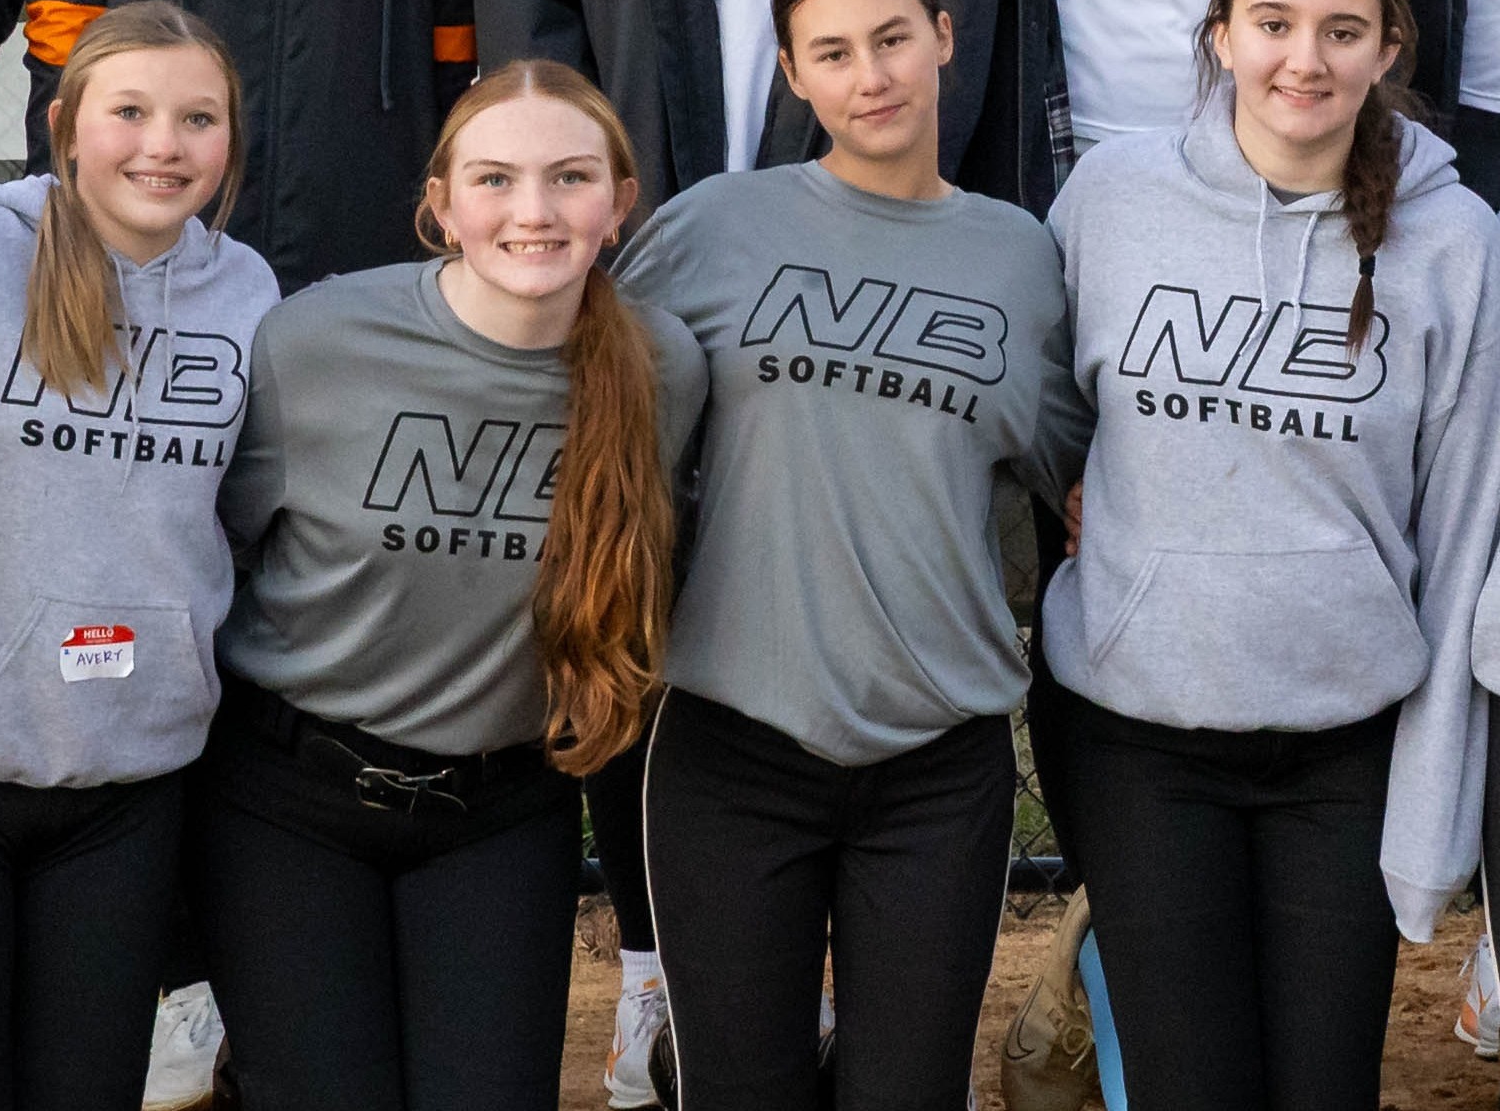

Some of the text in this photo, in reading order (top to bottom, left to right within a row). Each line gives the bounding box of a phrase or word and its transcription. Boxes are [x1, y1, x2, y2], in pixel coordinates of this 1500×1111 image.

[740, 263, 1008, 386] NB
[1119, 284, 1390, 403] NB
[758, 354, 977, 424] SOFTBALL
[1136, 389, 1358, 443] SOFTBALL
[83, 629, 114, 638] HELLO
